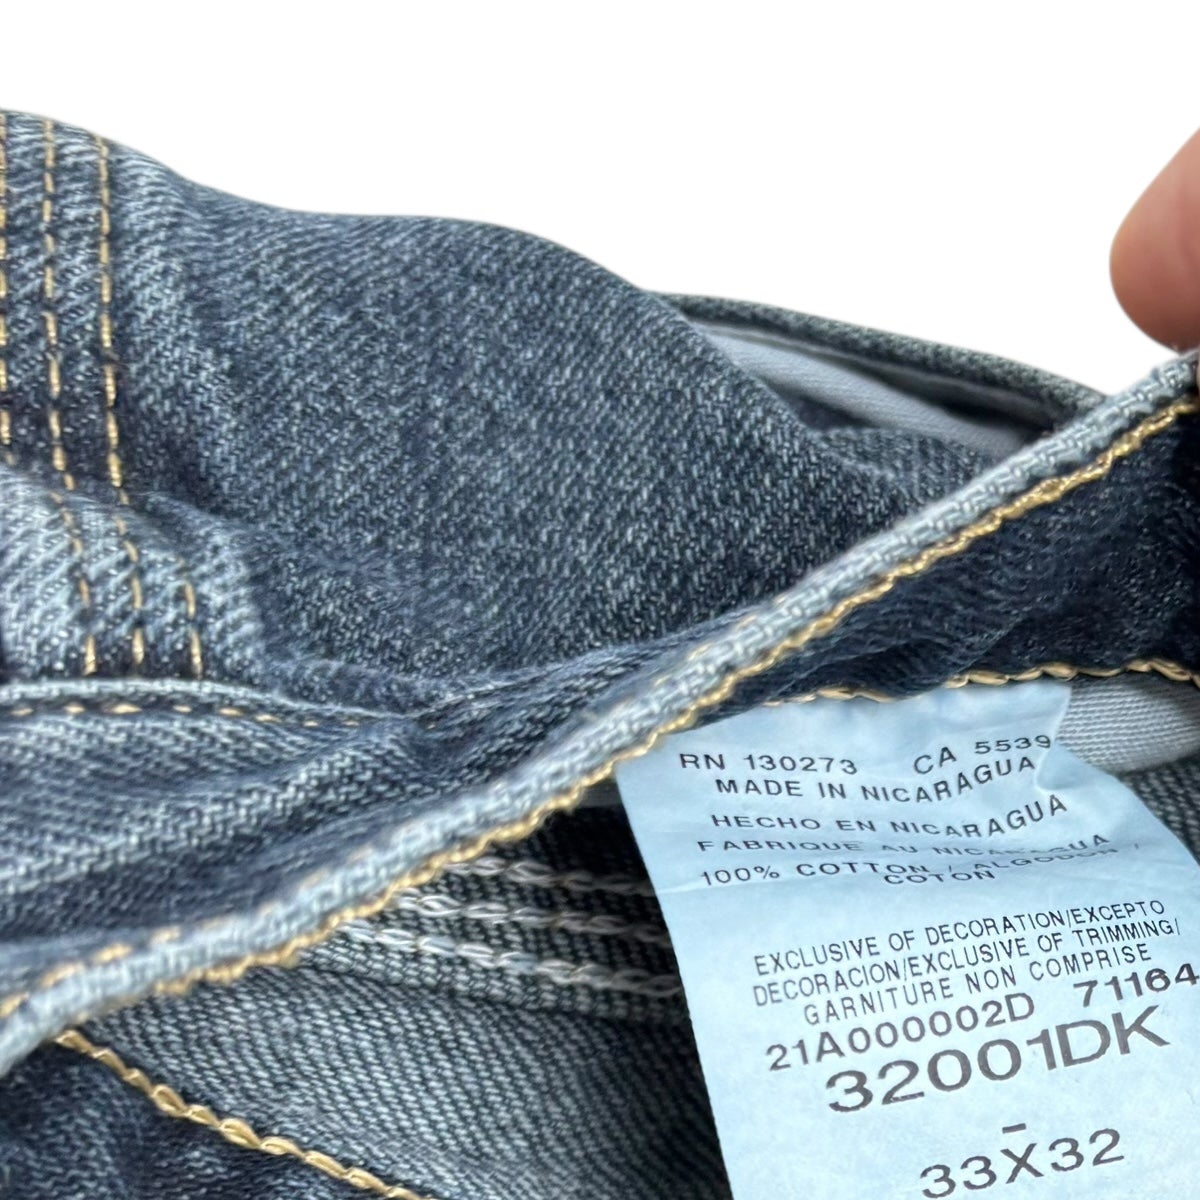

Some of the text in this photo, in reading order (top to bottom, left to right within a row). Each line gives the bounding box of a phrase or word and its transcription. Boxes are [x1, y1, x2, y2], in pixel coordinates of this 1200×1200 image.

[680, 734, 1052, 775] RN 130273 CA 5539
[716, 756, 1035, 803] MADE IN NICARAGUA
[711, 794, 1068, 838] HECHO EN NICARAGUA
[697, 840, 864, 852] FABRIQUE
[700, 865, 780, 886] 100%
[796, 862, 930, 876] COTTON
[884, 869, 995, 884] COTON
[753, 917, 1181, 1007] DECORACION/EXCLUSIVE OF TRIMMING/
[754, 900, 1166, 976] EXCLUSIVE OF DECORATION/EXCEPTO
[803, 943, 1152, 1025] GARNITURE NON COMPRISE
[765, 963, 1200, 1071] 21A000002D 71164
[826, 1004, 1171, 1113] 32001DK
[919, 1128, 1125, 1199] 33X32
